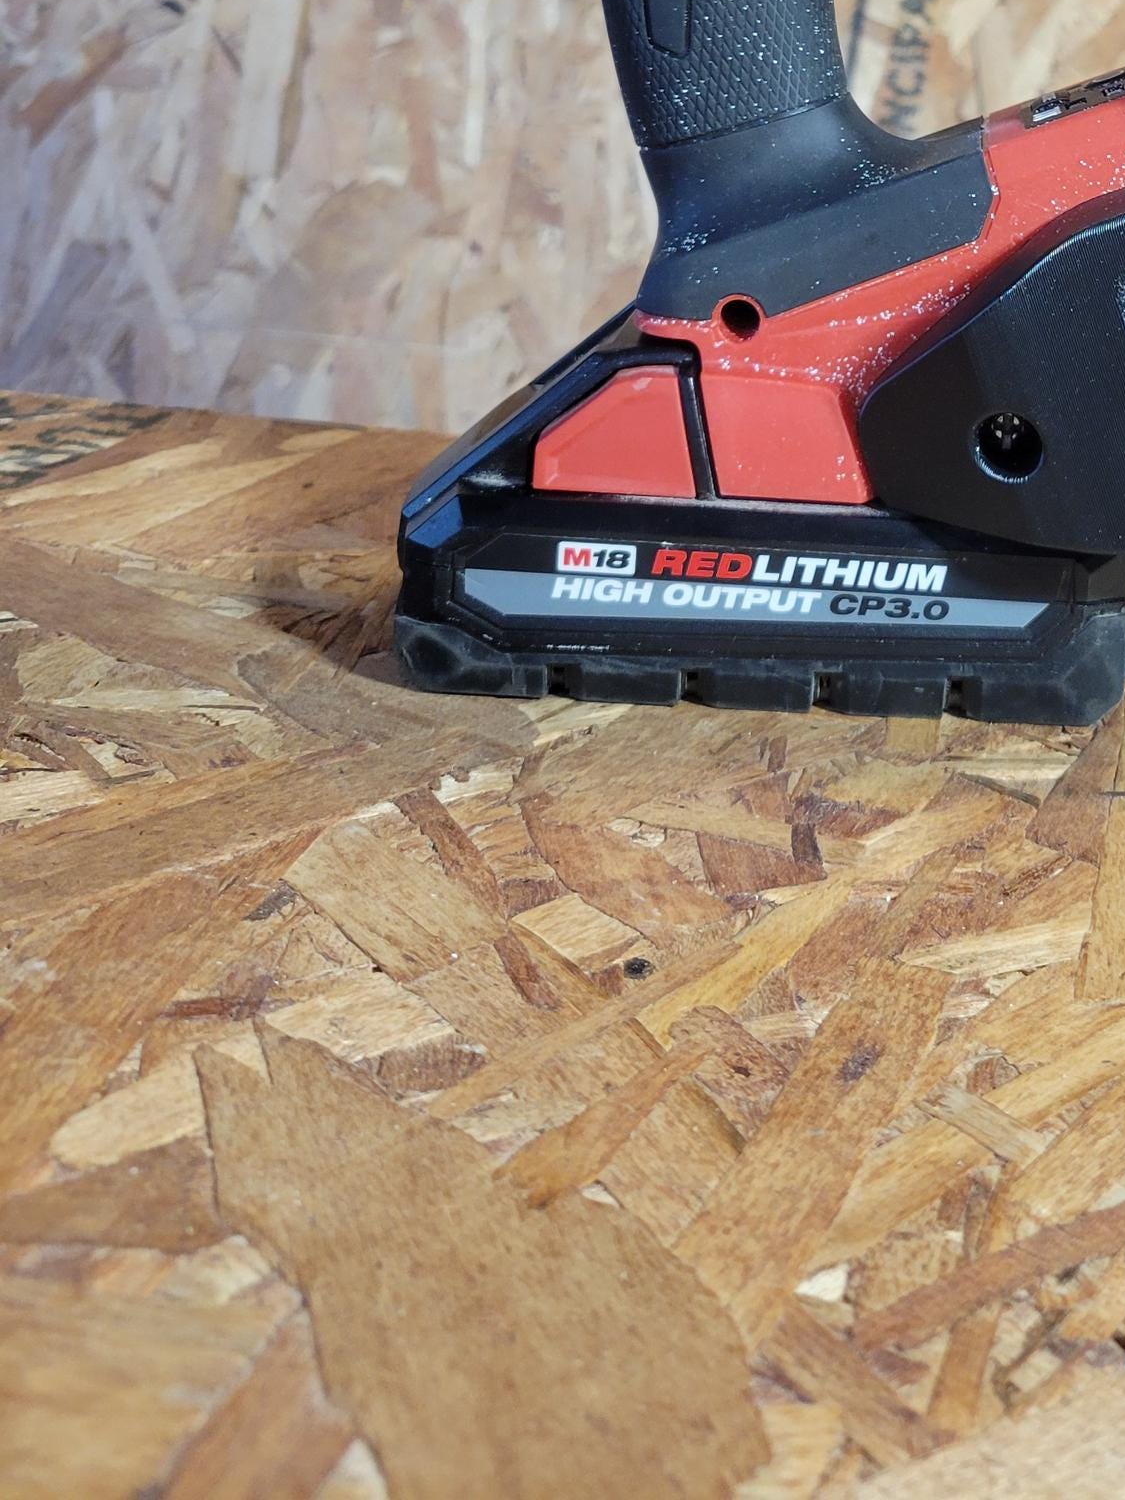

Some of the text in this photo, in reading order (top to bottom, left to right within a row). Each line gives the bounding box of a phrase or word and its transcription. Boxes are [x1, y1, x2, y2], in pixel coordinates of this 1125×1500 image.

[562, 546, 948, 593] M18 REDLITHIUM
[551, 576, 950, 621] HIGH OUTPUT CP3.0
